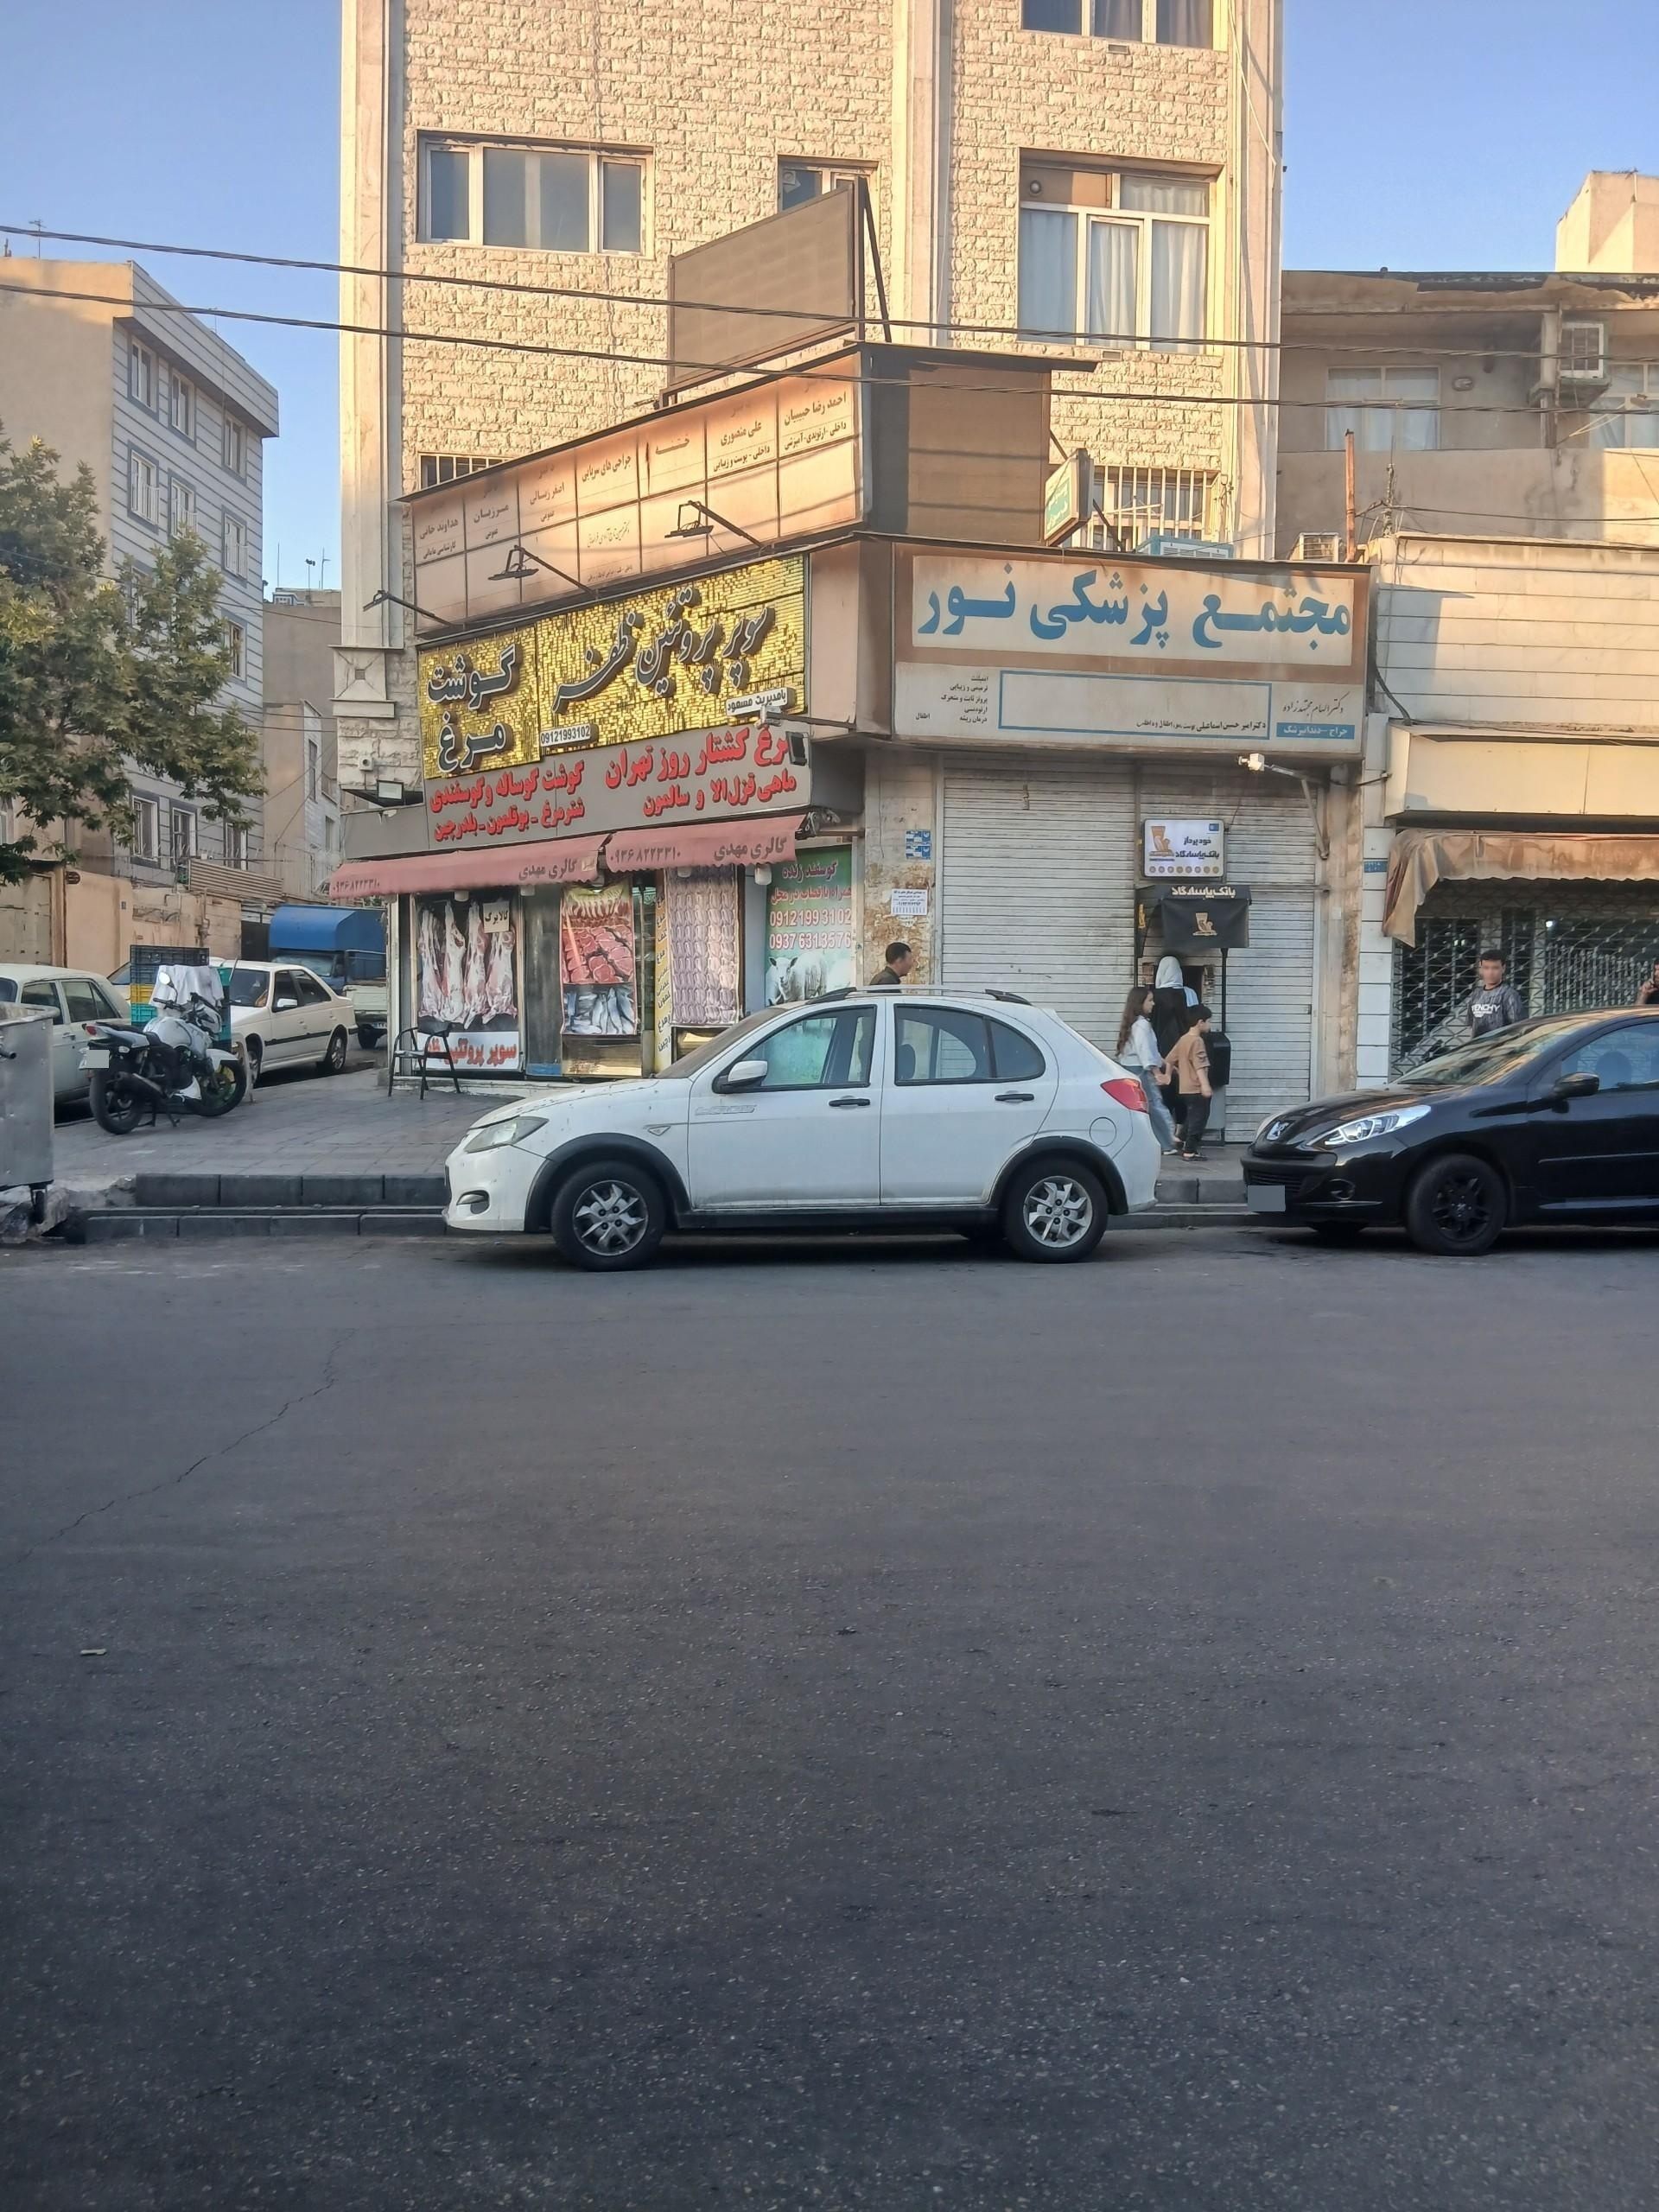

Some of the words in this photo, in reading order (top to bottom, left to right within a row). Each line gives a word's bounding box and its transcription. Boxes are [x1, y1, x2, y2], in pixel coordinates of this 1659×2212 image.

[812, 400, 826, 416] رضا
[827, 391, 847, 409] احمد
[917, 563, 1016, 636] نور
[1029, 569, 1169, 649] پزشکی
[1192, 588, 1351, 651] مجتمع
[635, 587, 716, 696] پروتئین
[721, 607, 770, 690] سوپر
[427, 643, 516, 710] گوشت
[552, 611, 638, 714] ظفر
[727, 698, 753, 712] مسعود
[915, 712, 931, 721] اطفال
[437, 711, 506, 773] مرغ
[540, 724, 590, 745] 09121993102
[657, 747, 690, 781] روز
[695, 727, 750, 775] کشتار
[542, 760, 585, 795] گوشت
[605, 745, 655, 790] تهران
[495, 767, 540, 801] گوساله
[696, 789, 705, 810] و
[757, 767, 798, 802] ماهی
[643, 785, 690, 817] سالمون
[434, 811, 478, 842] بلدرچین
[486, 804, 530, 836] بوقلمون
[714, 843, 749, 862] مهدی
[518, 864, 546, 880] مهدی
[782, 862, 804, 883] زنده
[804, 860, 839, 882] گوسفند
[770, 887, 788, 906] محل
[788, 890, 799, 906] در
[486, 1043, 517, 1068] سوپر
